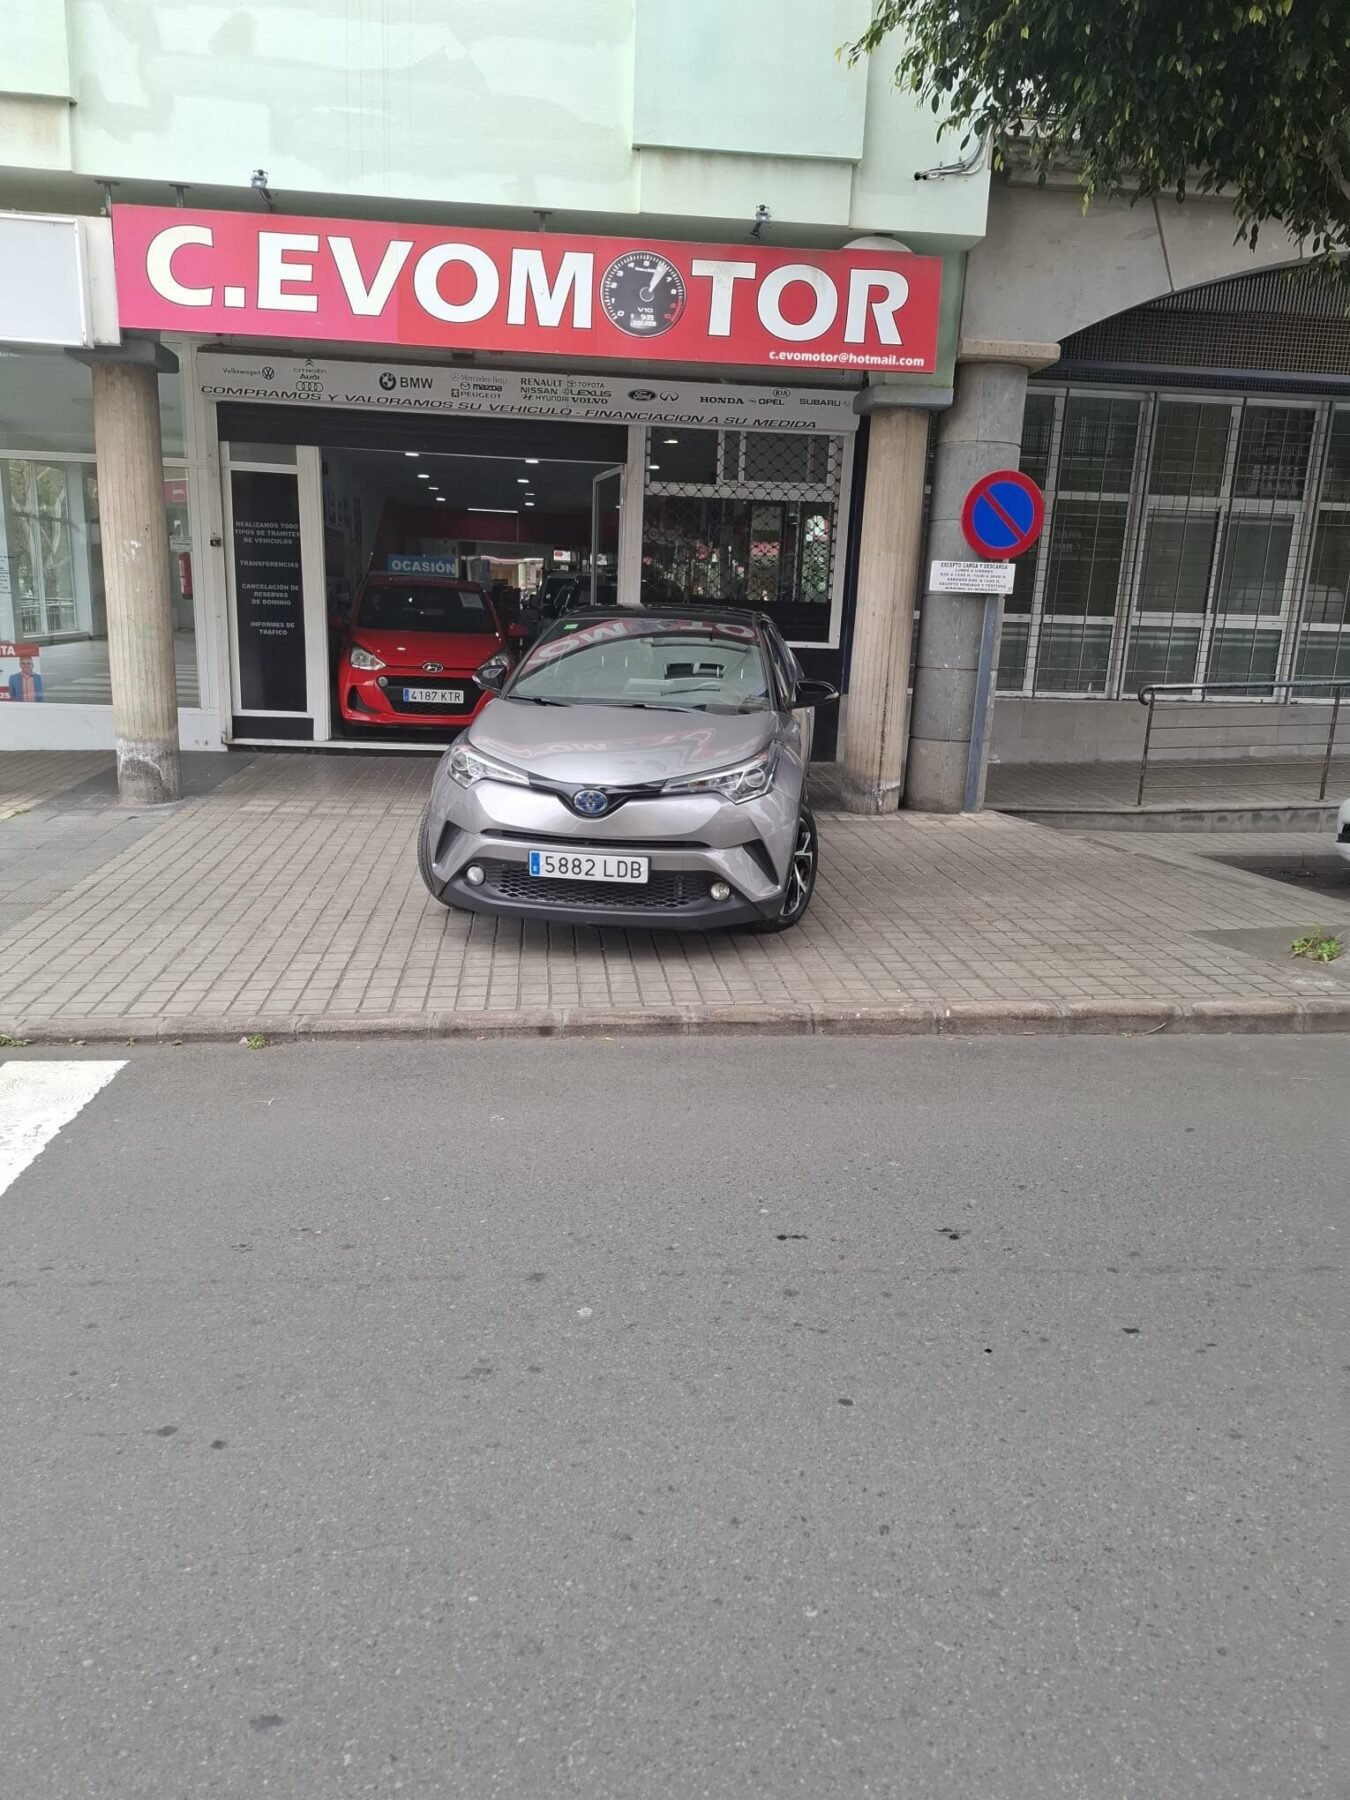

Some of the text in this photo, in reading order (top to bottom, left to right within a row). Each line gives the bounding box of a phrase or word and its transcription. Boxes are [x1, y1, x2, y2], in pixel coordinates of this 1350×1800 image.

[768, 350, 925, 367] c.evomotor@hotmail.com
[222, 367, 262, 377] Volkswagen
[400, 376, 434, 389] BMW
[520, 377, 563, 387] RENAULT
[577, 381, 605, 389] TOYOTA
[472, 383, 503, 392] mazda
[520, 386, 558, 395] NISSAN
[460, 391, 502, 399] PEUGEOT
[569, 389, 612, 398] LEXUS
[630, 390, 654, 400] Ford
[571, 396, 608, 404] VOLVO
[699, 396, 745, 405] HONDA
[758, 398, 785, 406] OPEL
[799, 398, 841, 407] SUBARU
[201, 385, 321, 401] COMPRAMOS
[327, 394, 338, 402] Y
[345, 394, 453, 409] VALORAMOS
[458, 402, 482, 410] SU
[489, 404, 572, 416] VEHICULO
[584, 409, 705, 423] FINANCIACION
[708, 416, 720, 424] A
[724, 417, 748, 425] SU
[752, 419, 817, 429] MEDIDA
[235, 521, 279, 529] REALIZAMOS
[240, 560, 299, 569] TRANSFERENCIAS
[391, 559, 456, 574] OCASIÓN
[411, 691, 461, 702] 4187 KTR
[545, 855, 642, 879] 5882 LDB
